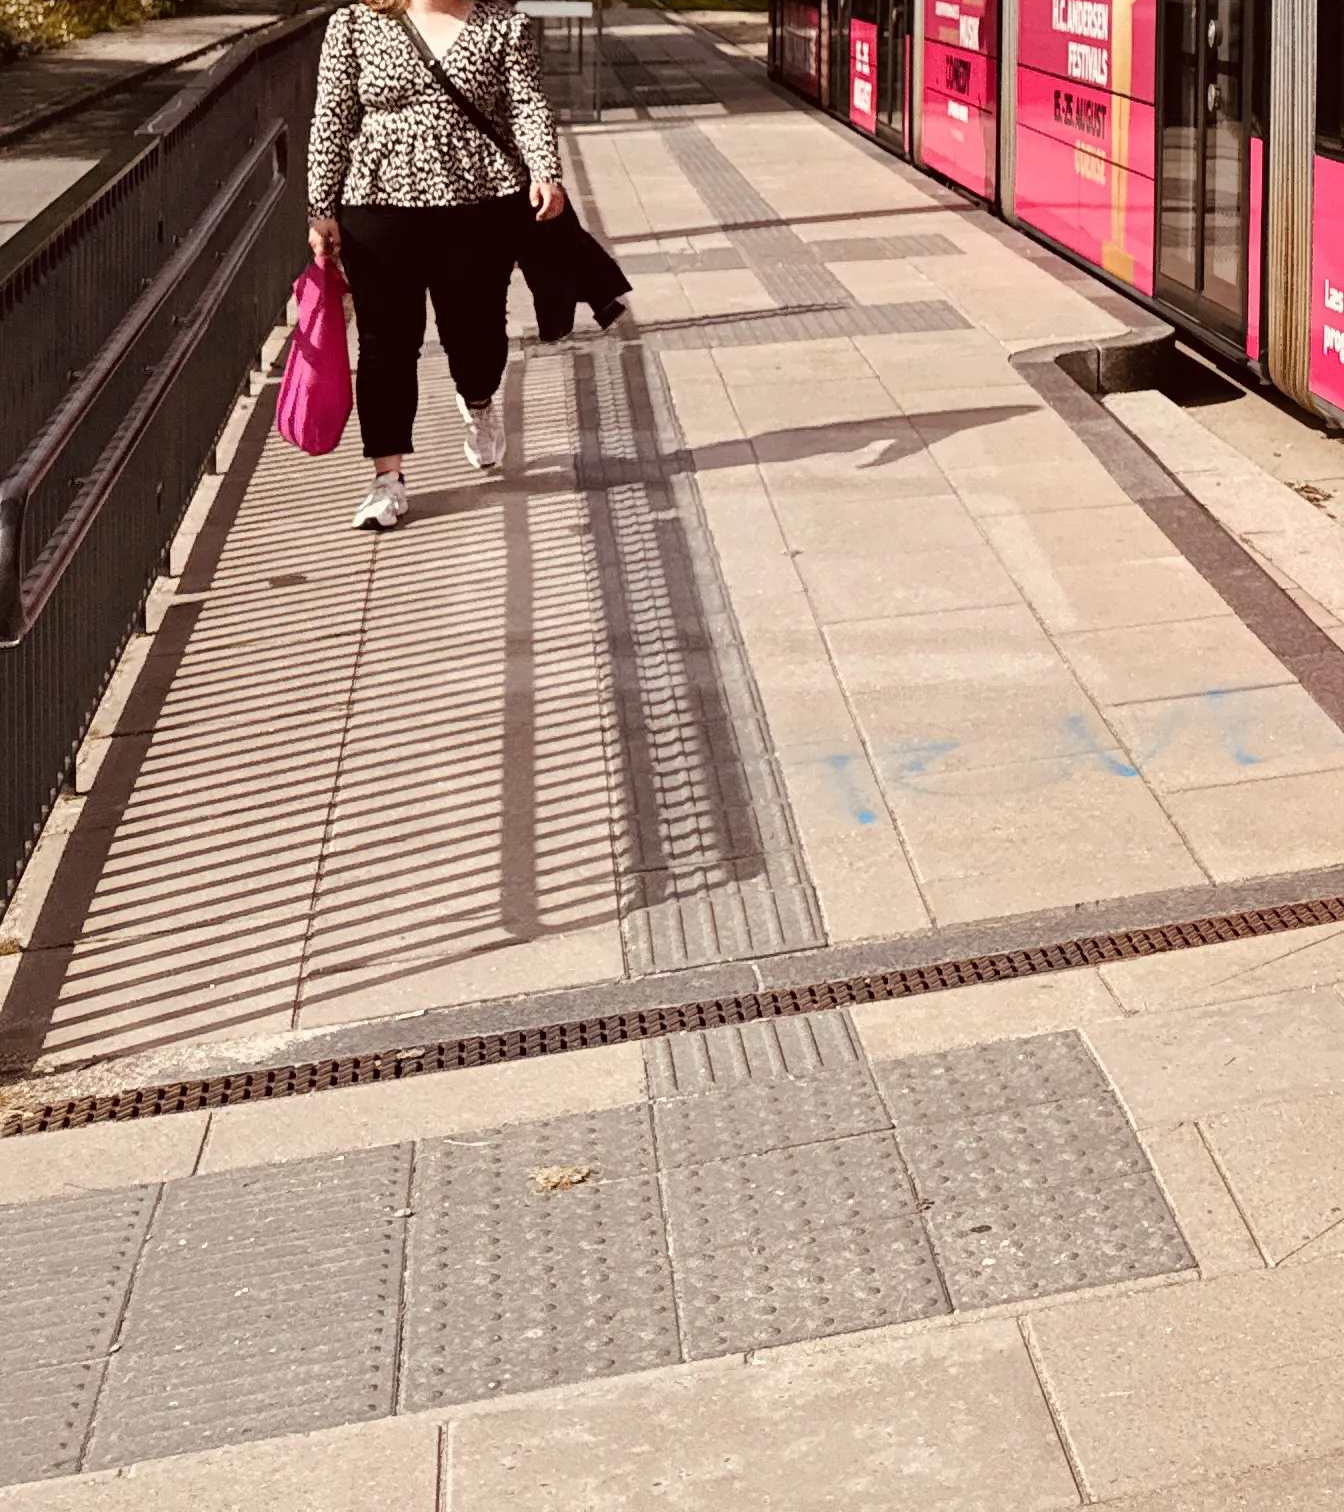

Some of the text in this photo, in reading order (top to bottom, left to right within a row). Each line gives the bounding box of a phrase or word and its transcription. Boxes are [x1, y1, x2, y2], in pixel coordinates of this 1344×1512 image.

[1068, 41, 1108, 86] FESTIVALS
[1076, 96, 1107, 140] AUGUST
[1324, 279, 1344, 313] Læs
